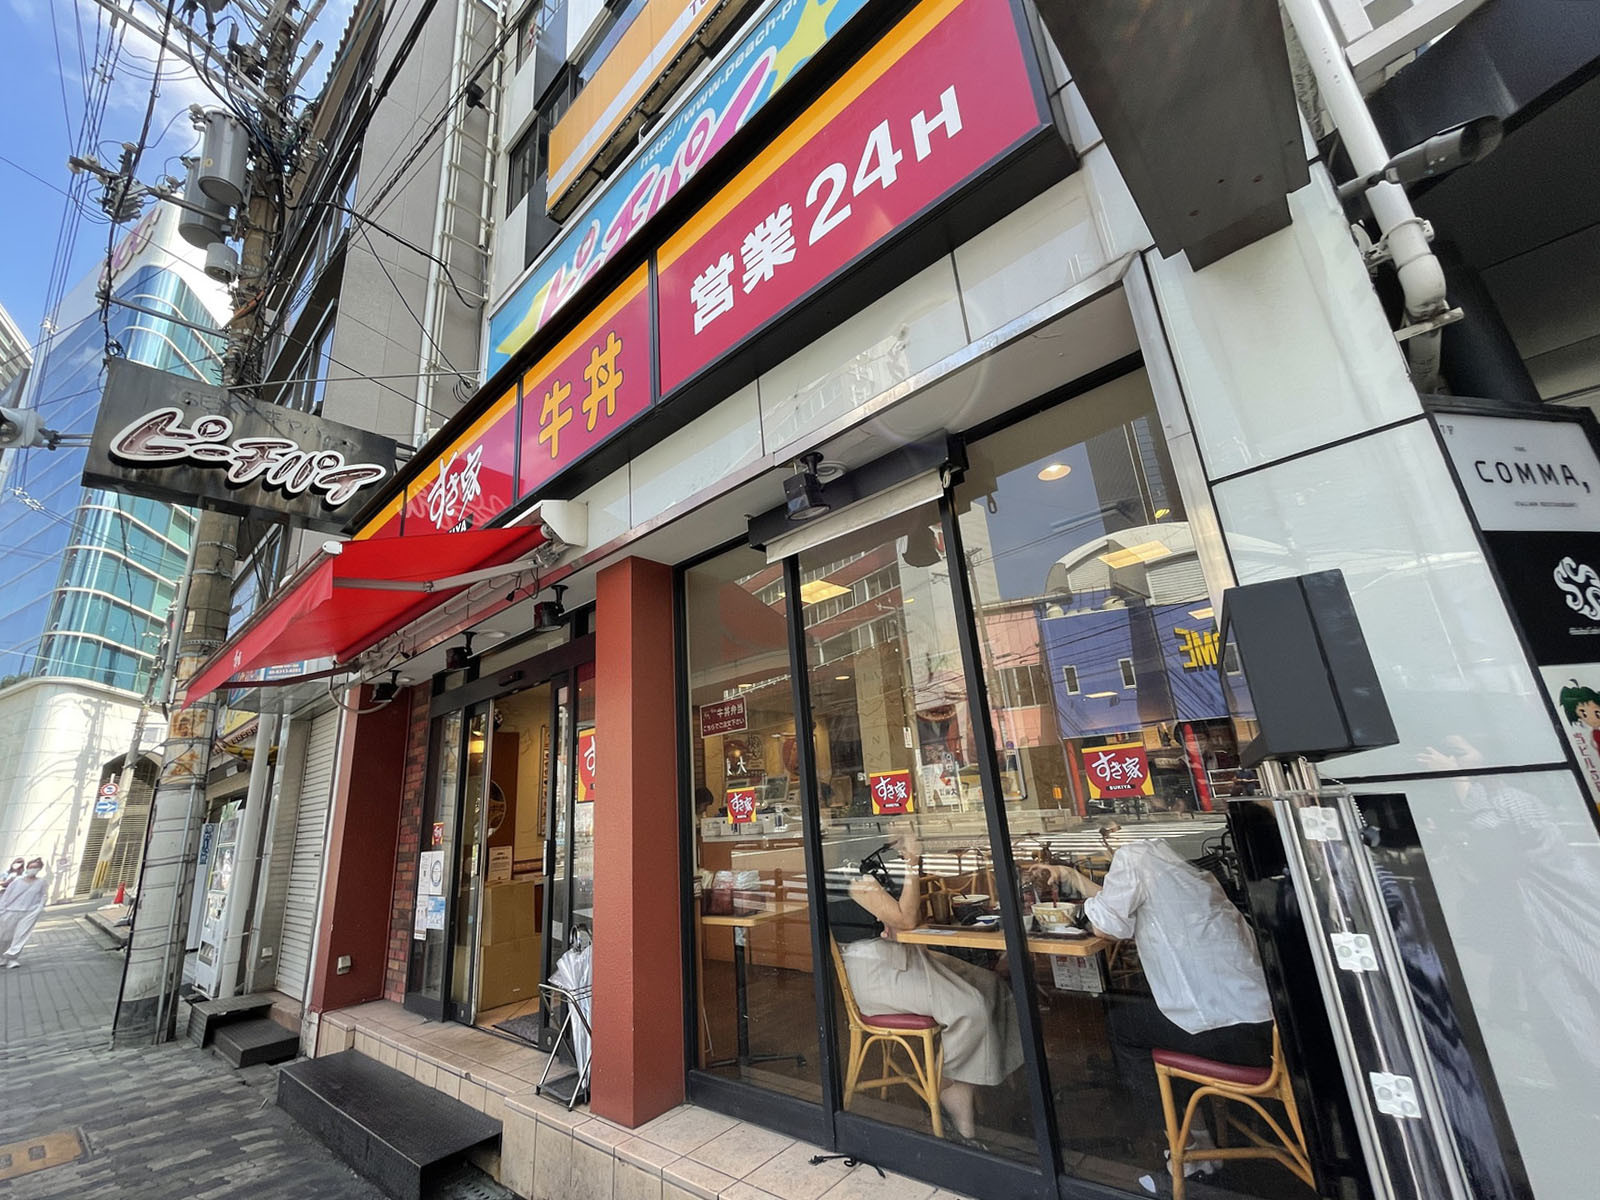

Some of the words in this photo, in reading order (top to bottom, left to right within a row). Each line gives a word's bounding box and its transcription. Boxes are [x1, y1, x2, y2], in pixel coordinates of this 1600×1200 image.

[640, 0, 798, 170] http://www.peach-p
[538, 330, 624, 460] 牛丼
[427, 444, 483, 530] すき家
[875, 777, 908, 802] すき家
[1091, 752, 1143, 783] すき家
[731, 792, 753, 814] すき家
